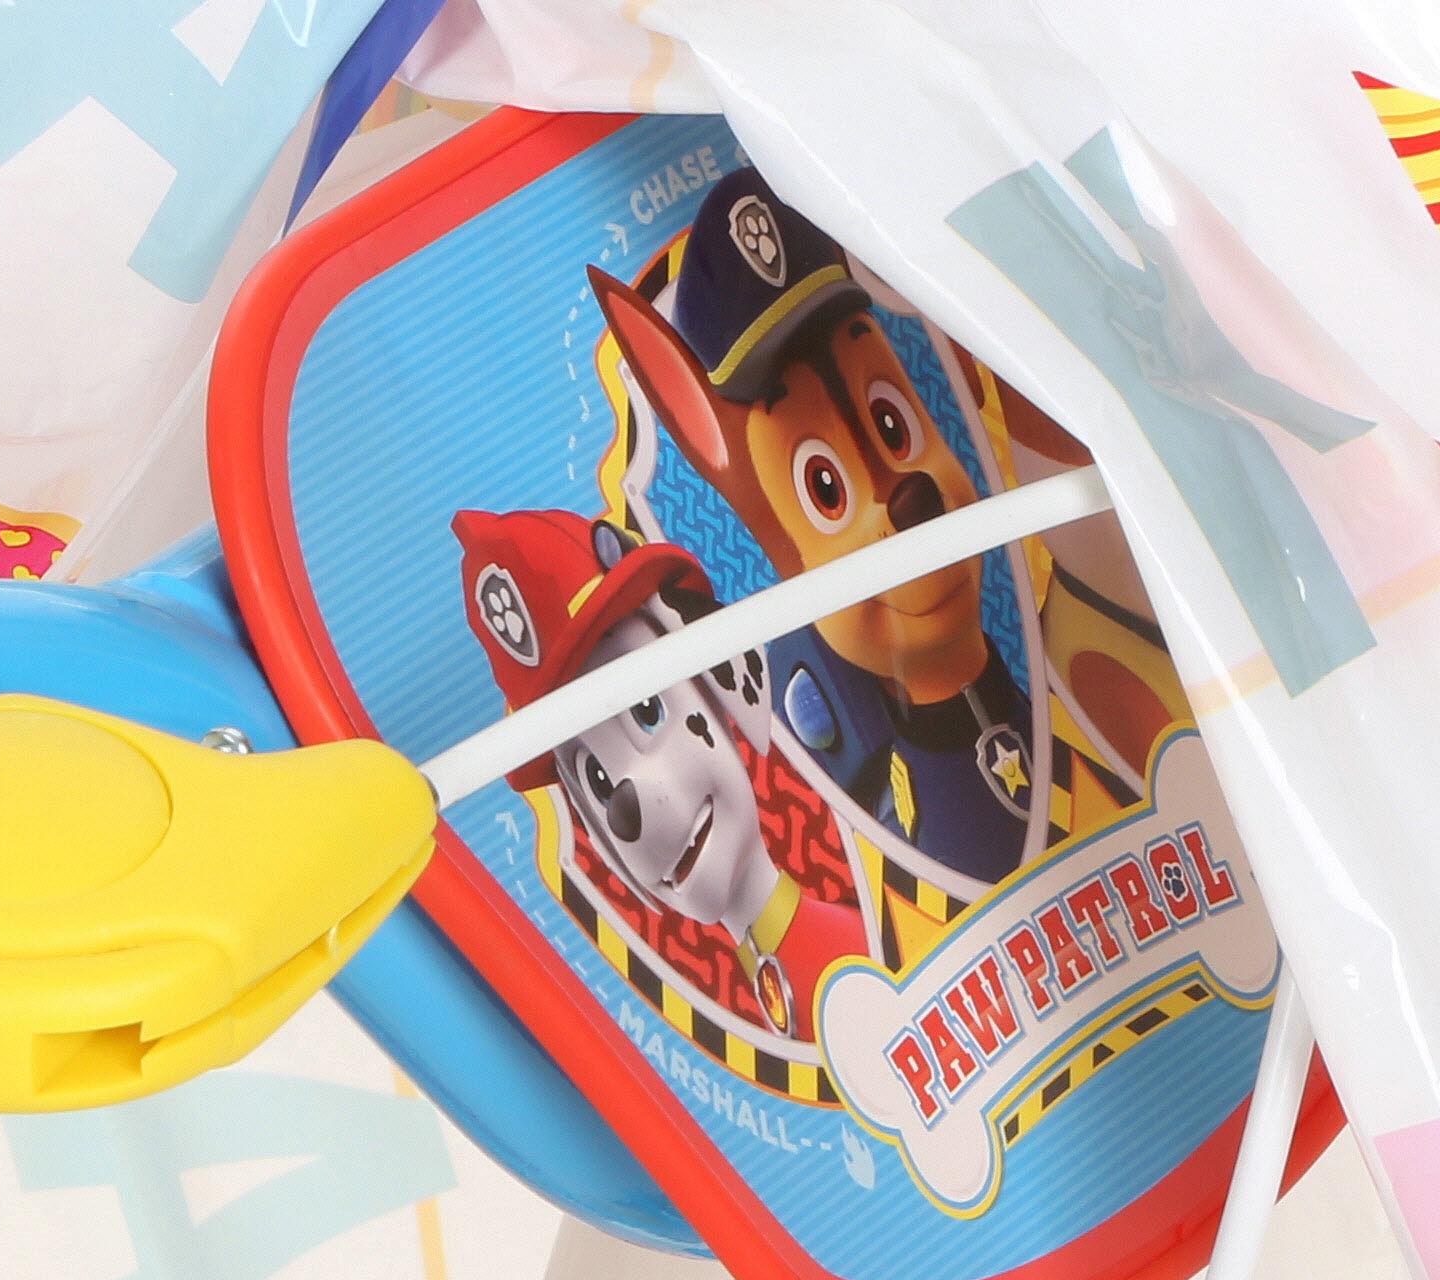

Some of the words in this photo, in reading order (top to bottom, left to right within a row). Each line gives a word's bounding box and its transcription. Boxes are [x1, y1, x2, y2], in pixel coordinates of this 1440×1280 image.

[629, 144, 723, 225] CHASE
[884, 946, 1027, 1130] PAW
[998, 820, 1244, 1022] PATROL
[619, 1000, 800, 1155] MARSHALL
